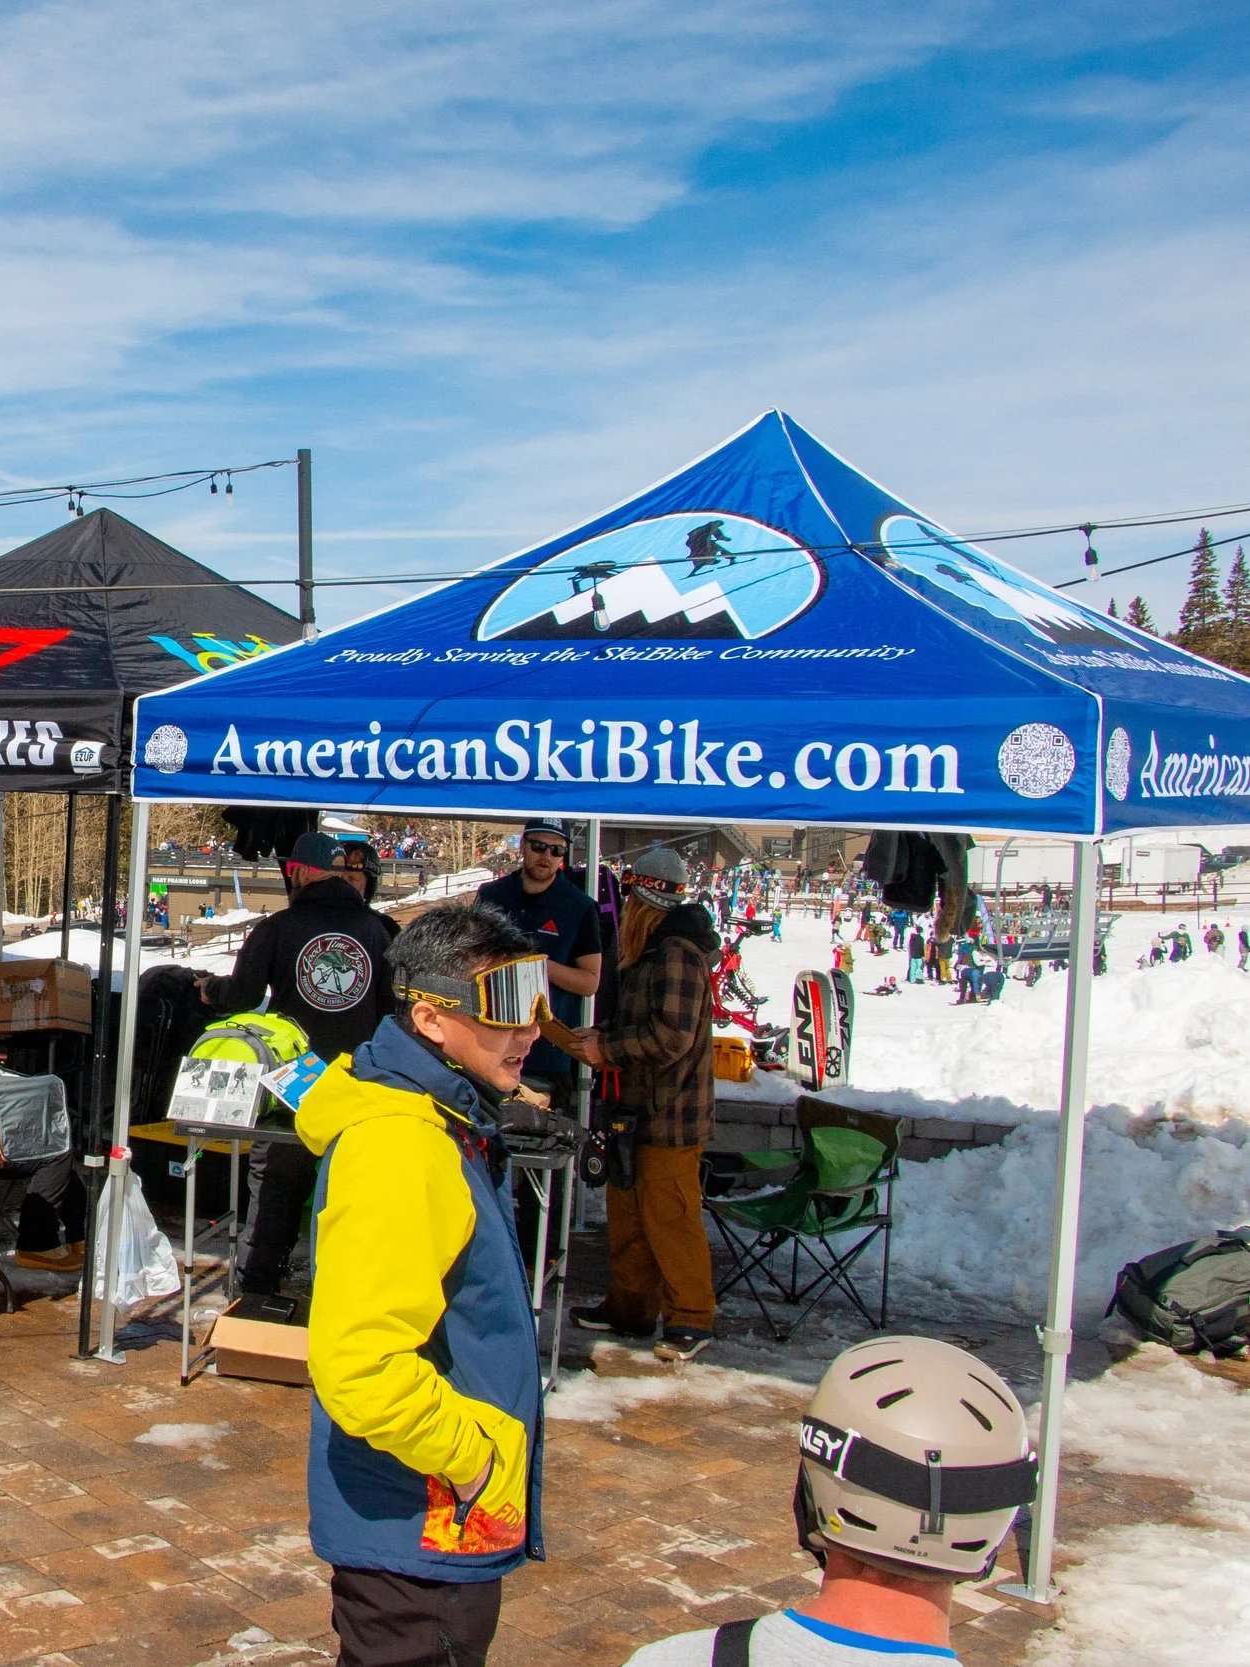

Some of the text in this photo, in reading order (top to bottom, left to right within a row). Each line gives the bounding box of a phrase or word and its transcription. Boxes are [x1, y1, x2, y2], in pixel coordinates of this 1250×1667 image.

[324, 644, 917, 666] Proudly Serving the SkiBike Community
[210, 718, 965, 795] AmericanSkiBike.com
[302, 940, 322, 973] Good
[325, 937, 350, 952] Time
[793, 979, 820, 1093] LENZ
[830, 970, 851, 1052] LENZ
